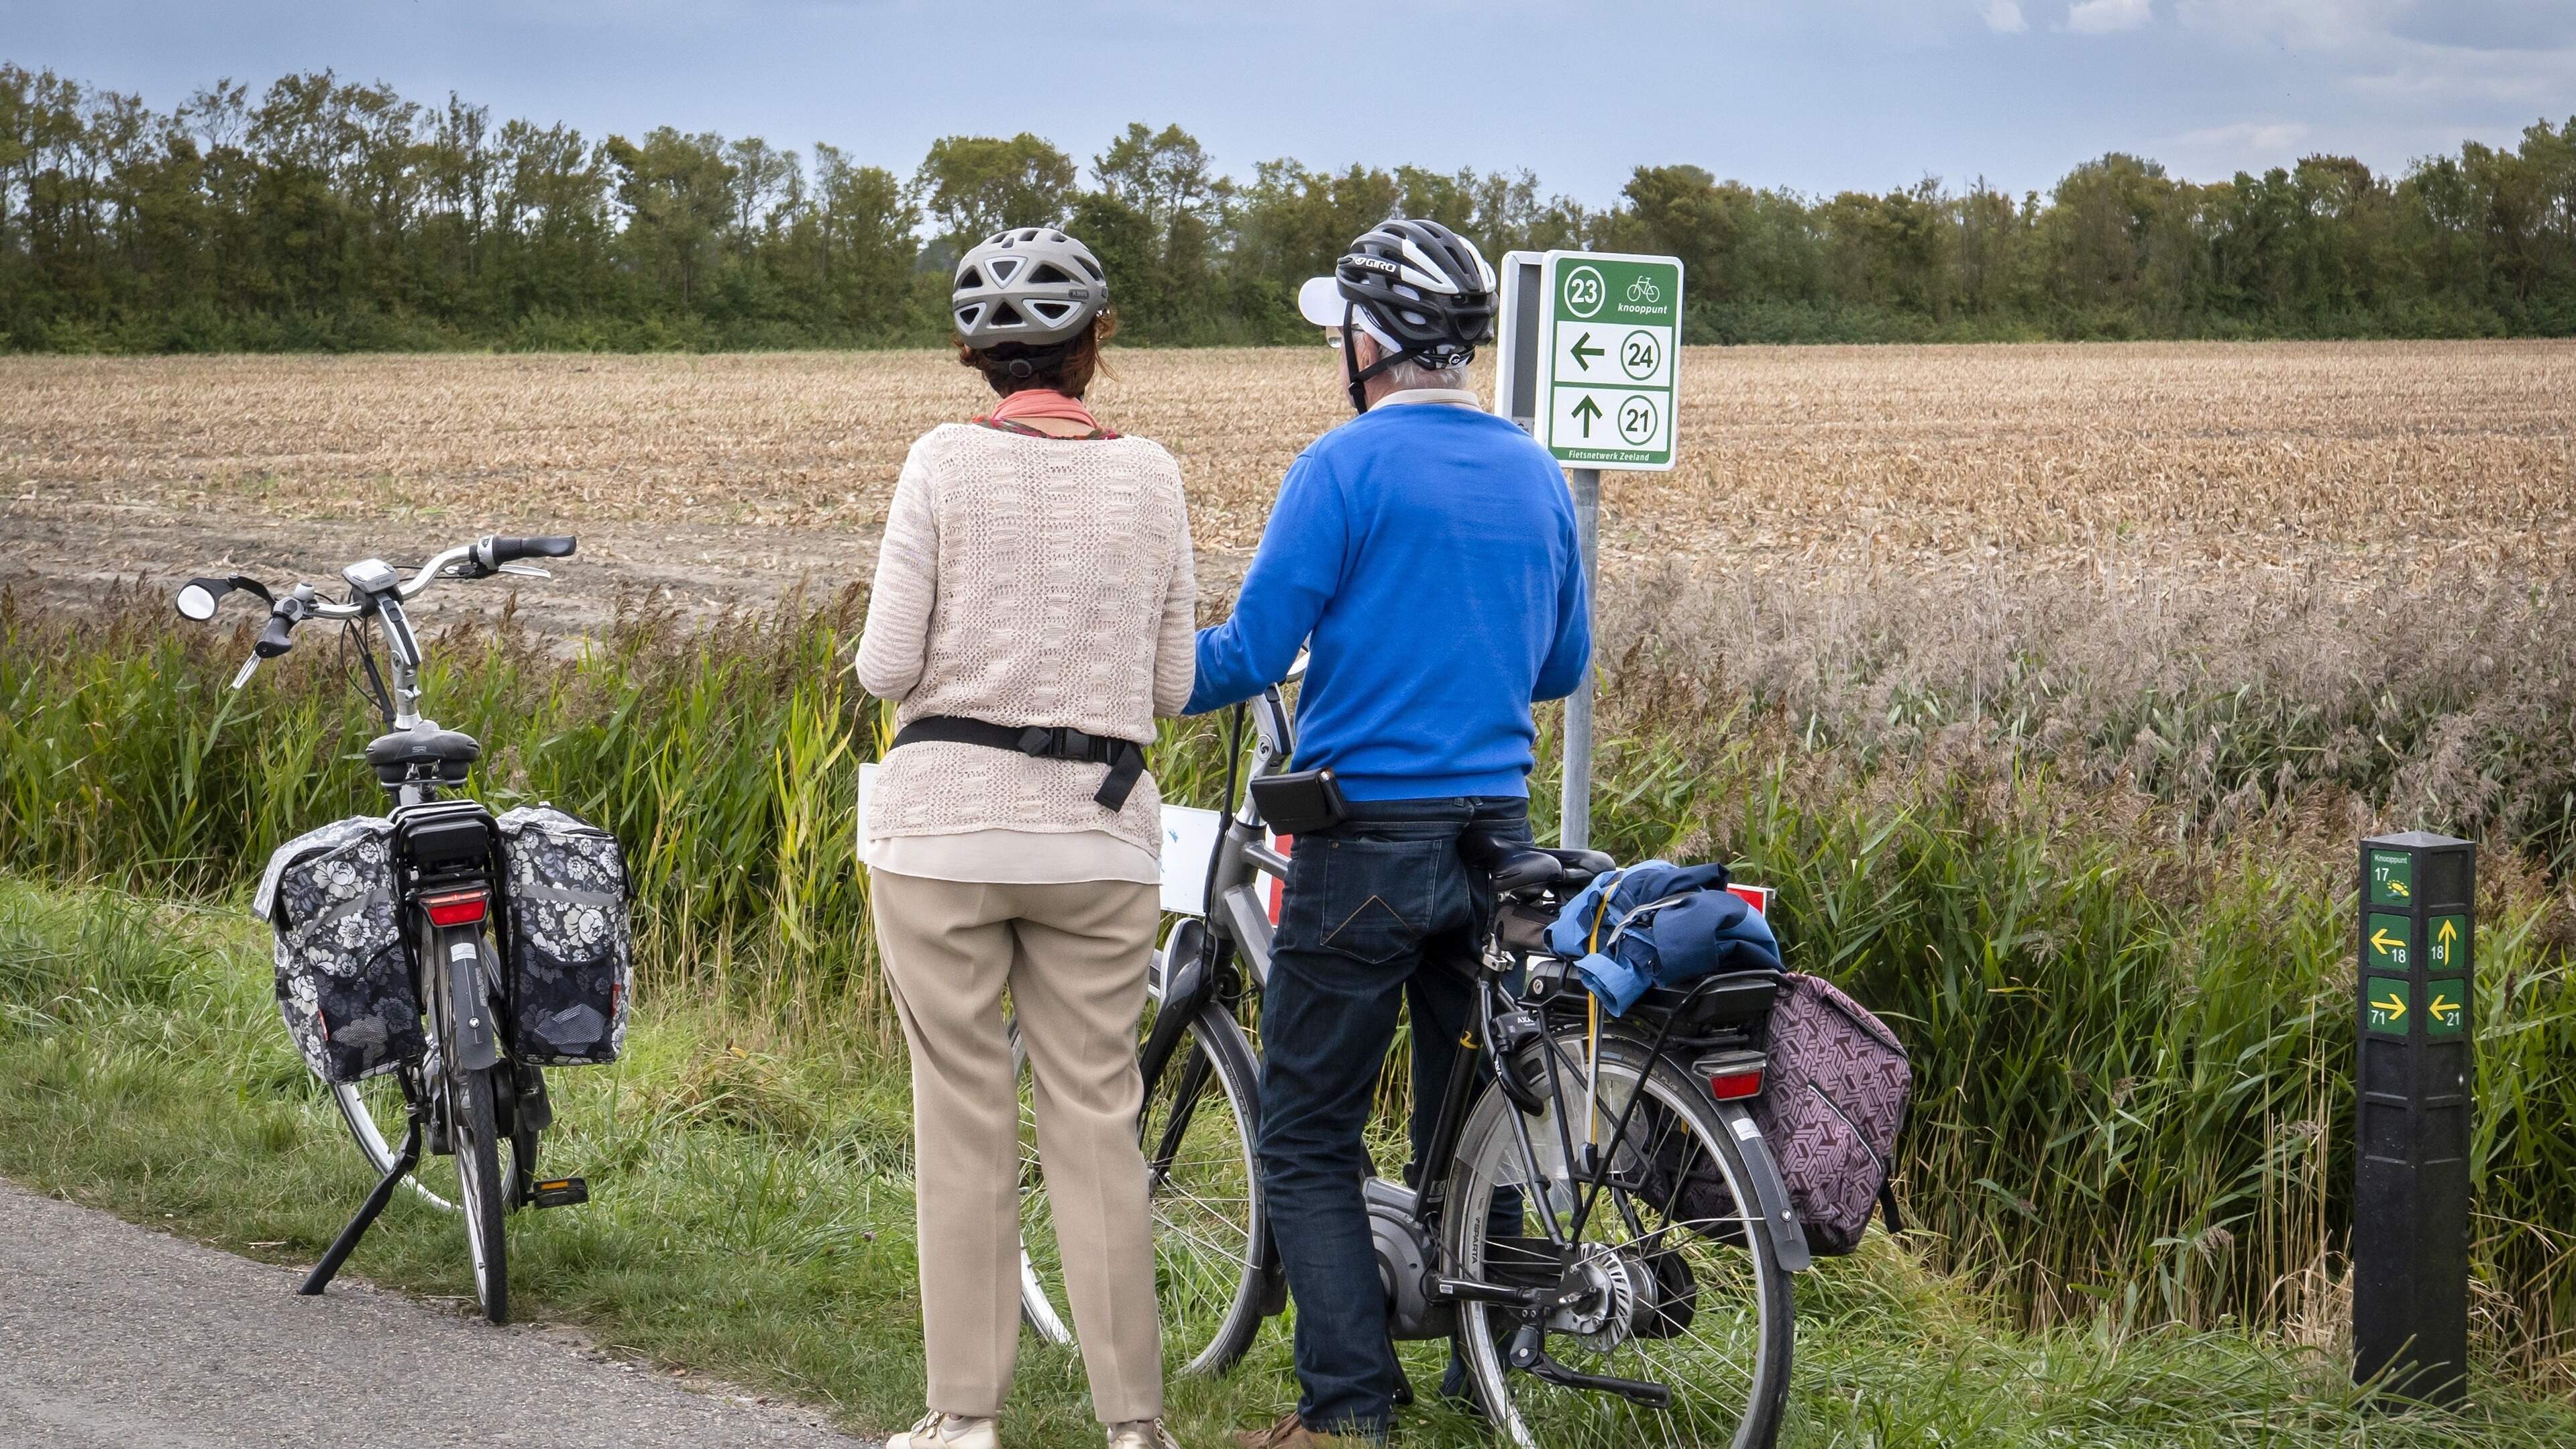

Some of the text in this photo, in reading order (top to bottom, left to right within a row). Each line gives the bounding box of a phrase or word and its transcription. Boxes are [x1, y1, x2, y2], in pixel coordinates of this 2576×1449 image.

[1366, 258, 1397, 273] GIRO
[1571, 278, 1597, 304] 23
[1617, 302, 1668, 315] knooppunt
[1627, 343, 1653, 368] 24
[1625, 408, 1650, 433] 21
[1568, 450, 1650, 462] Fietsnetwerk Zeeland
[2374, 854, 2408, 865] Knooppunt
[2375, 867, 2390, 882] 17
[2391, 948, 2406, 963] 18
[2430, 945, 2444, 960] 18
[2371, 1010, 2385, 1025] 71
[2447, 1012, 2460, 1026] 21
[1472, 1222, 1481, 1264] SPARTA
